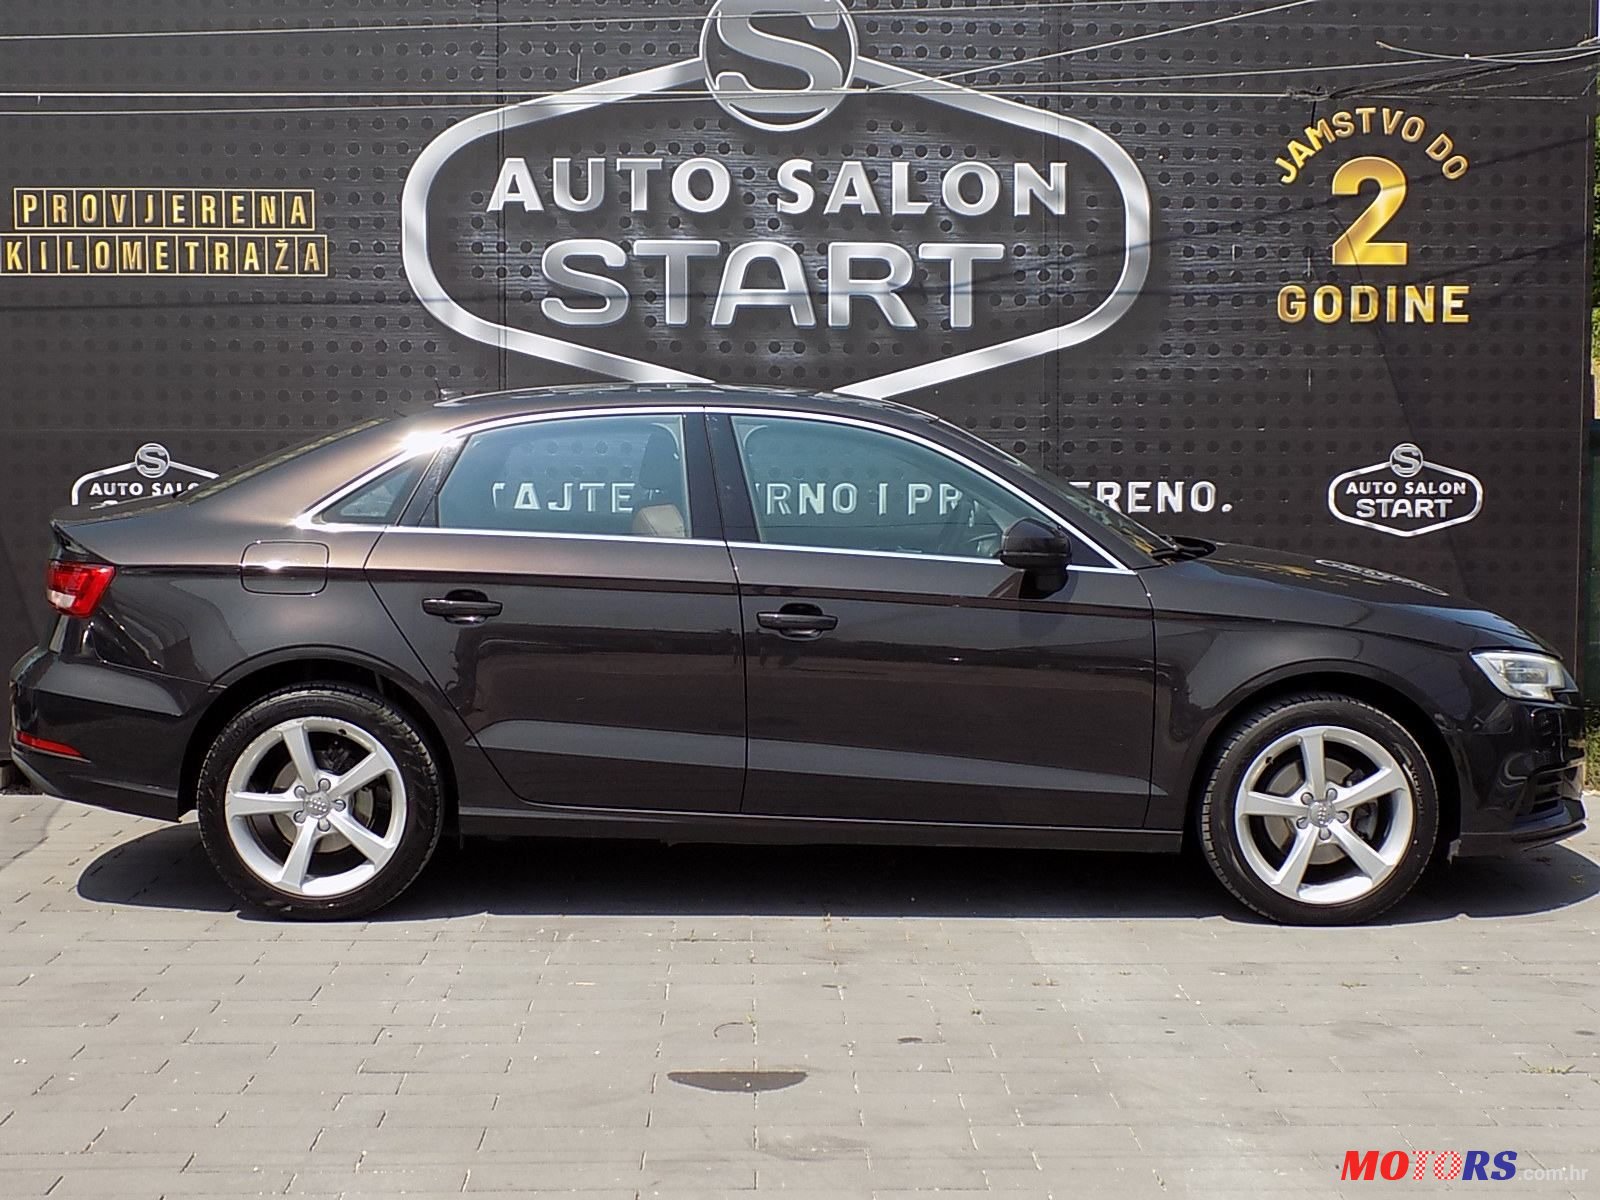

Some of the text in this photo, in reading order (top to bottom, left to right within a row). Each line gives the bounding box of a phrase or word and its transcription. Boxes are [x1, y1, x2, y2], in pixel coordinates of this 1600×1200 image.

[1275, 107, 1468, 184] JAMSTVO DO
[486, 157, 1068, 216] AUTO SALON
[22, 194, 307, 225] PROVJERENA
[1331, 156, 1408, 266] 2
[6, 240, 321, 271] KILOMETRAŽA
[540, 239, 1005, 329] START
[1277, 285, 1470, 323] GODINE
[90, 482, 143, 496] AUTO
[755, 482, 858, 515] RNO
[1069, 481, 1232, 513] RENO.
[1346, 482, 1466, 495] AUTO SALON
[1355, 499, 1453, 518] START
